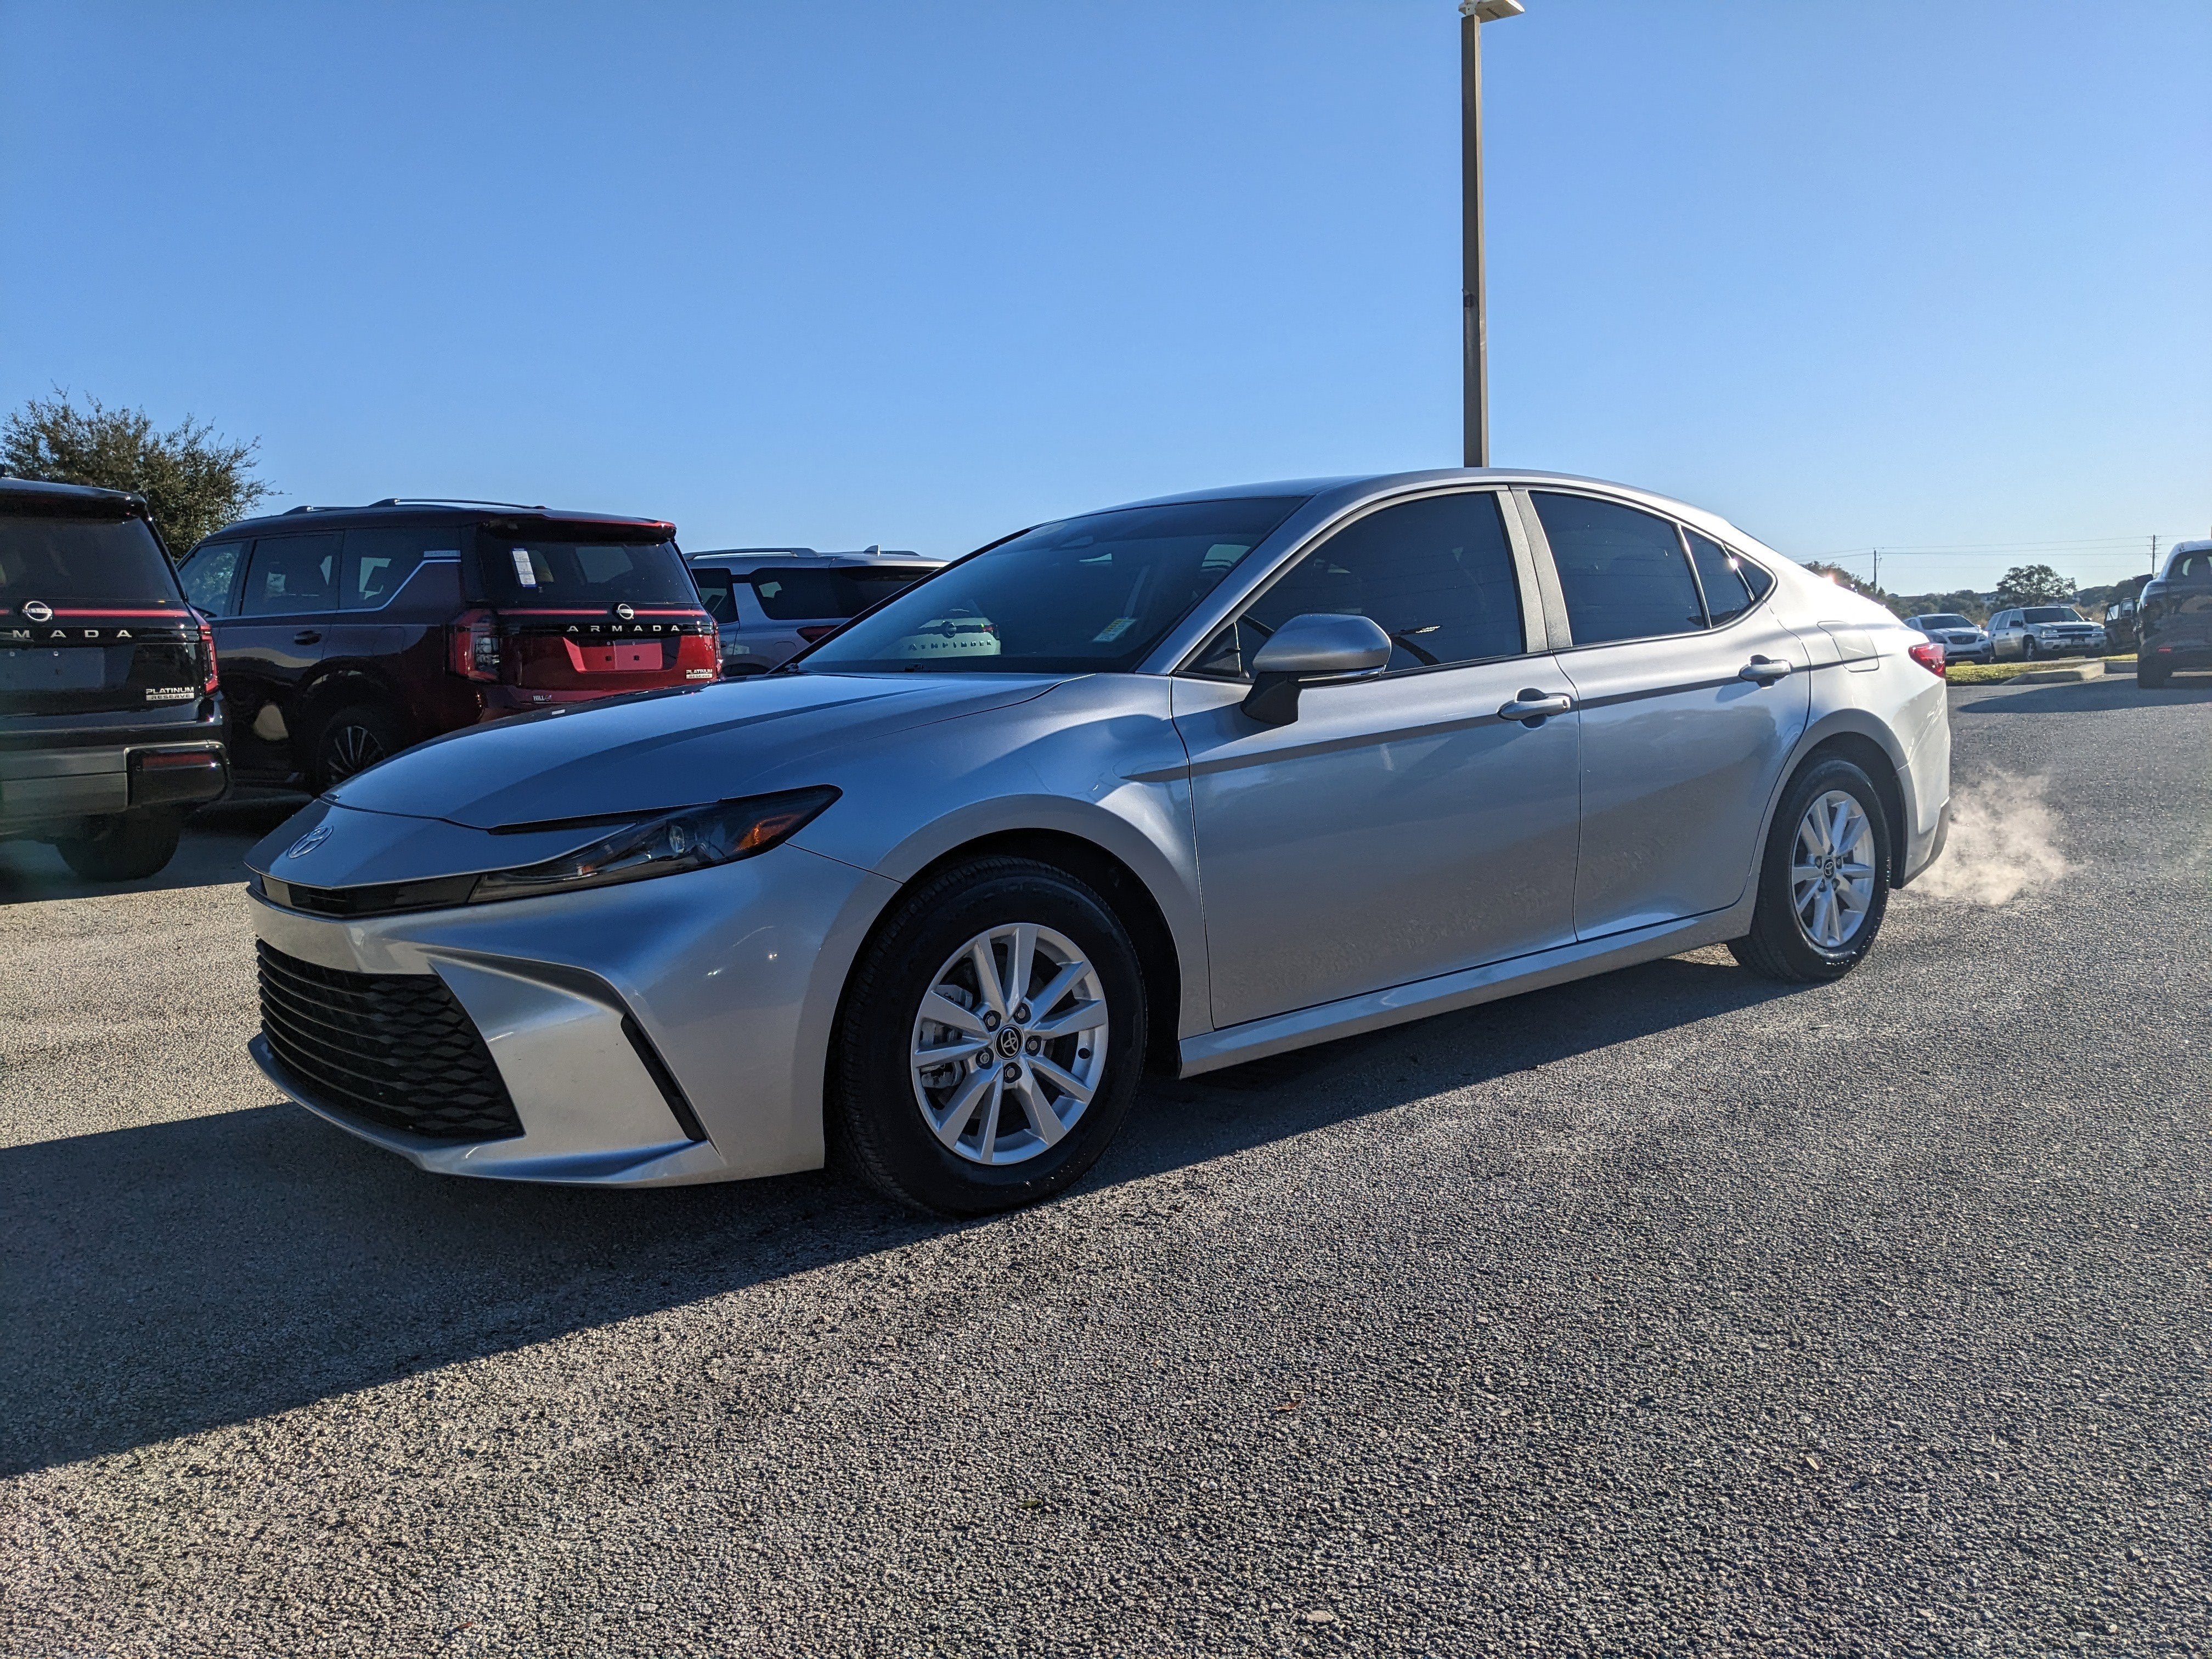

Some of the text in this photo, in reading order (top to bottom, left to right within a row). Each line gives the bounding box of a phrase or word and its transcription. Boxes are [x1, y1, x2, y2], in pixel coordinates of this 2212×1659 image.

[12, 630, 133, 639] MADA
[901, 640, 992, 651] ATHFINDER
[145, 686, 194, 695] PLATINUM
